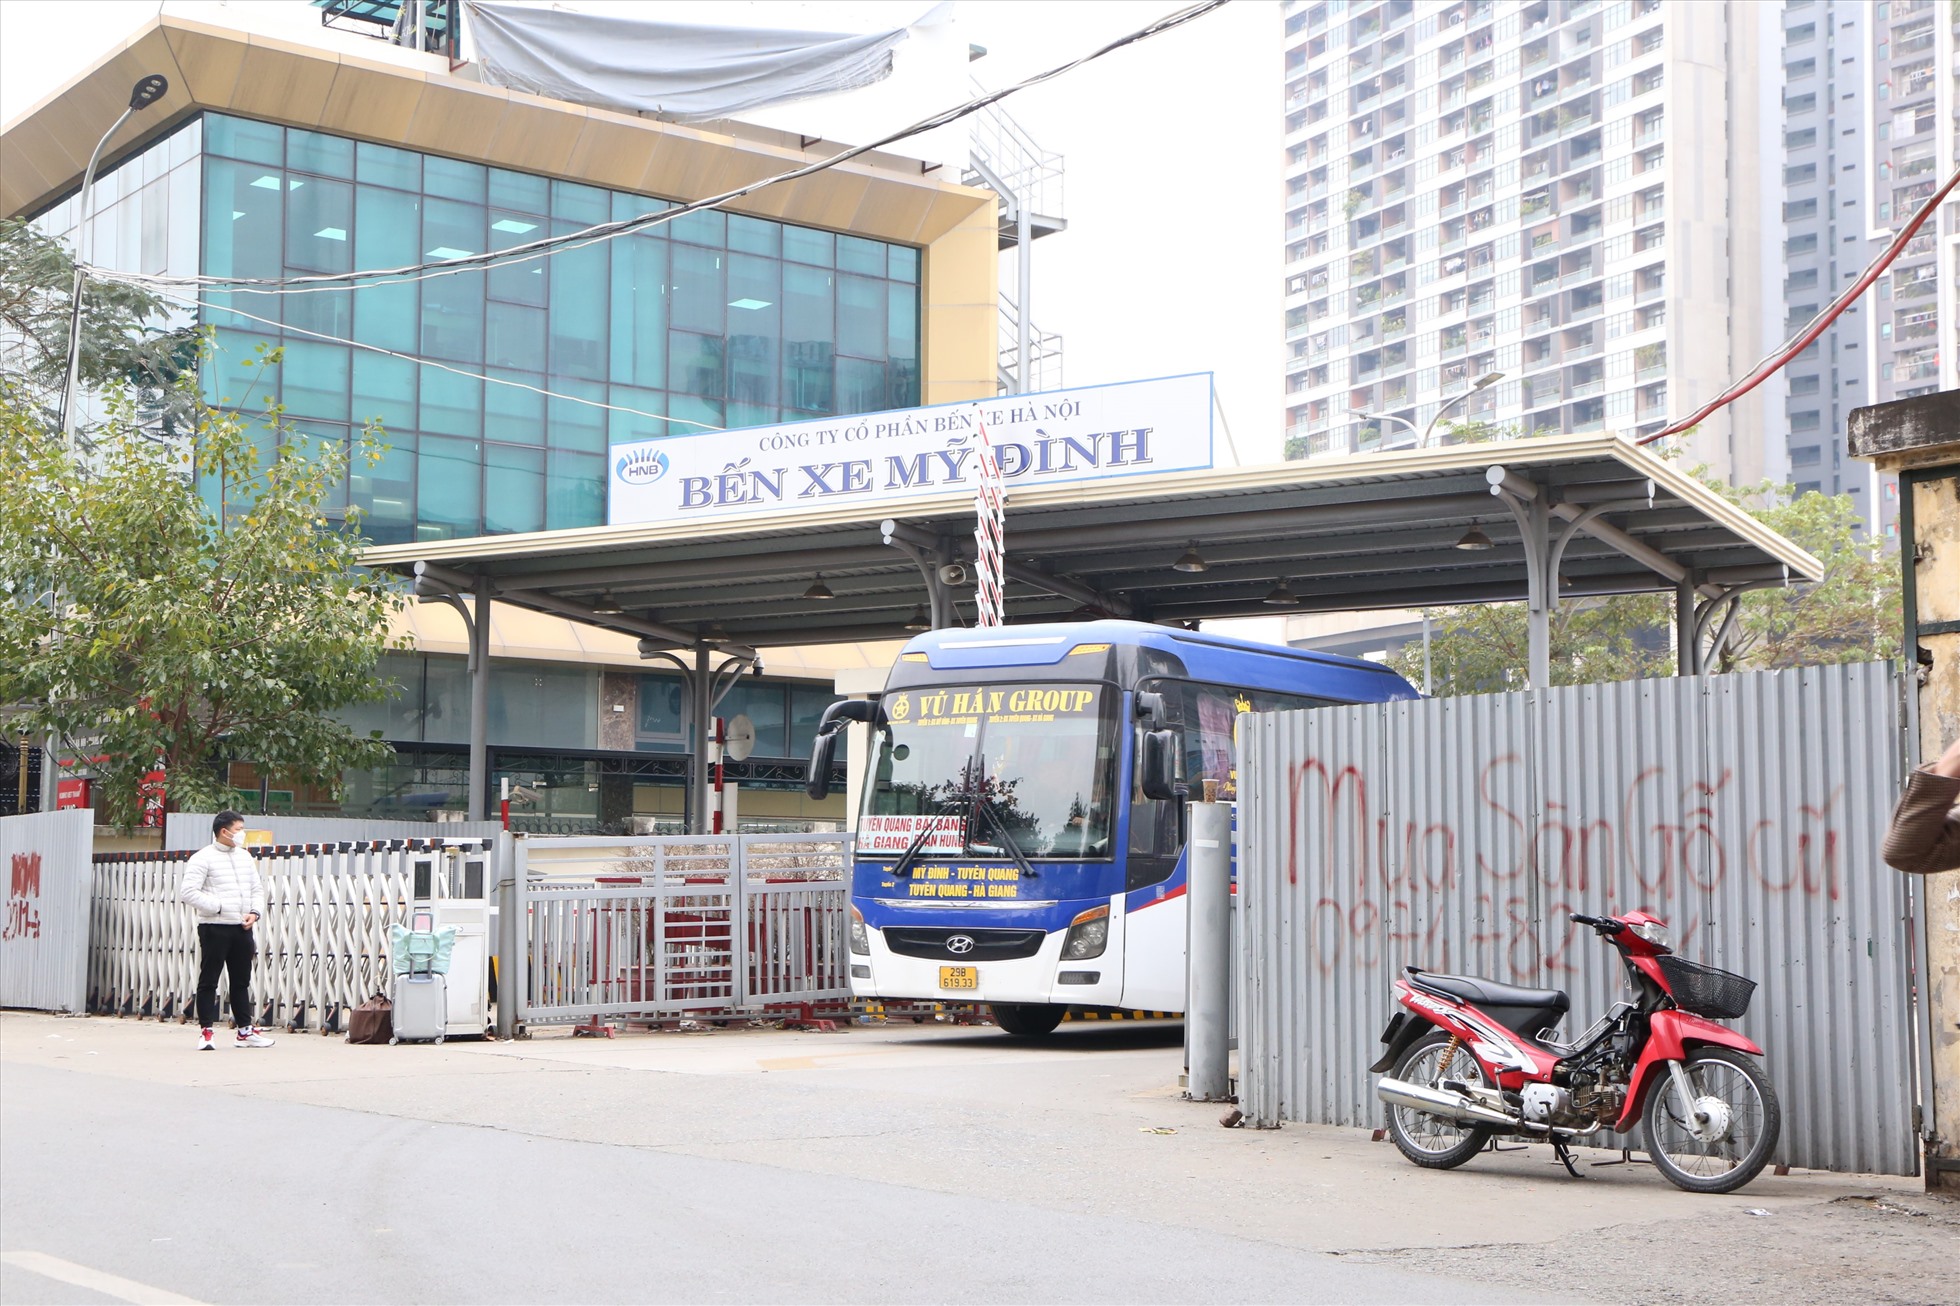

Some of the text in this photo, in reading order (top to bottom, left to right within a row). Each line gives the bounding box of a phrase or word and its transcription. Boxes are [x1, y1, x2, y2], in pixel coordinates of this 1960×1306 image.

[759, 432, 809, 451] CÔNG
[816, 429, 839, 445] TY
[844, 418, 869, 442] CỔ
[875, 414, 928, 439] PHẦN
[934, 409, 972, 432] BẾN
[1010, 401, 1037, 424] HÀ
[1044, 398, 1081, 421] NỘI
[628, 464, 659, 477] HNB
[678, 427, 1153, 510] BẾN XE MỸ ĐÌNH
[920, 687, 1093, 717] VŨ HÁN GROUP
[884, 817, 912, 832] QUANG
[874, 836, 909, 849] GIANG
[912, 865, 926, 879] MỸ
[928, 865, 949, 880] ĐÌNH
[957, 865, 985, 880] TUYÊN
[988, 868, 1019, 882] QUANG
[909, 882, 936, 897] TUYÊN
[988, 884, 1017, 897] GIANG
[950, 967, 966, 977] 29B
[944, 977, 973, 988] 619.33
